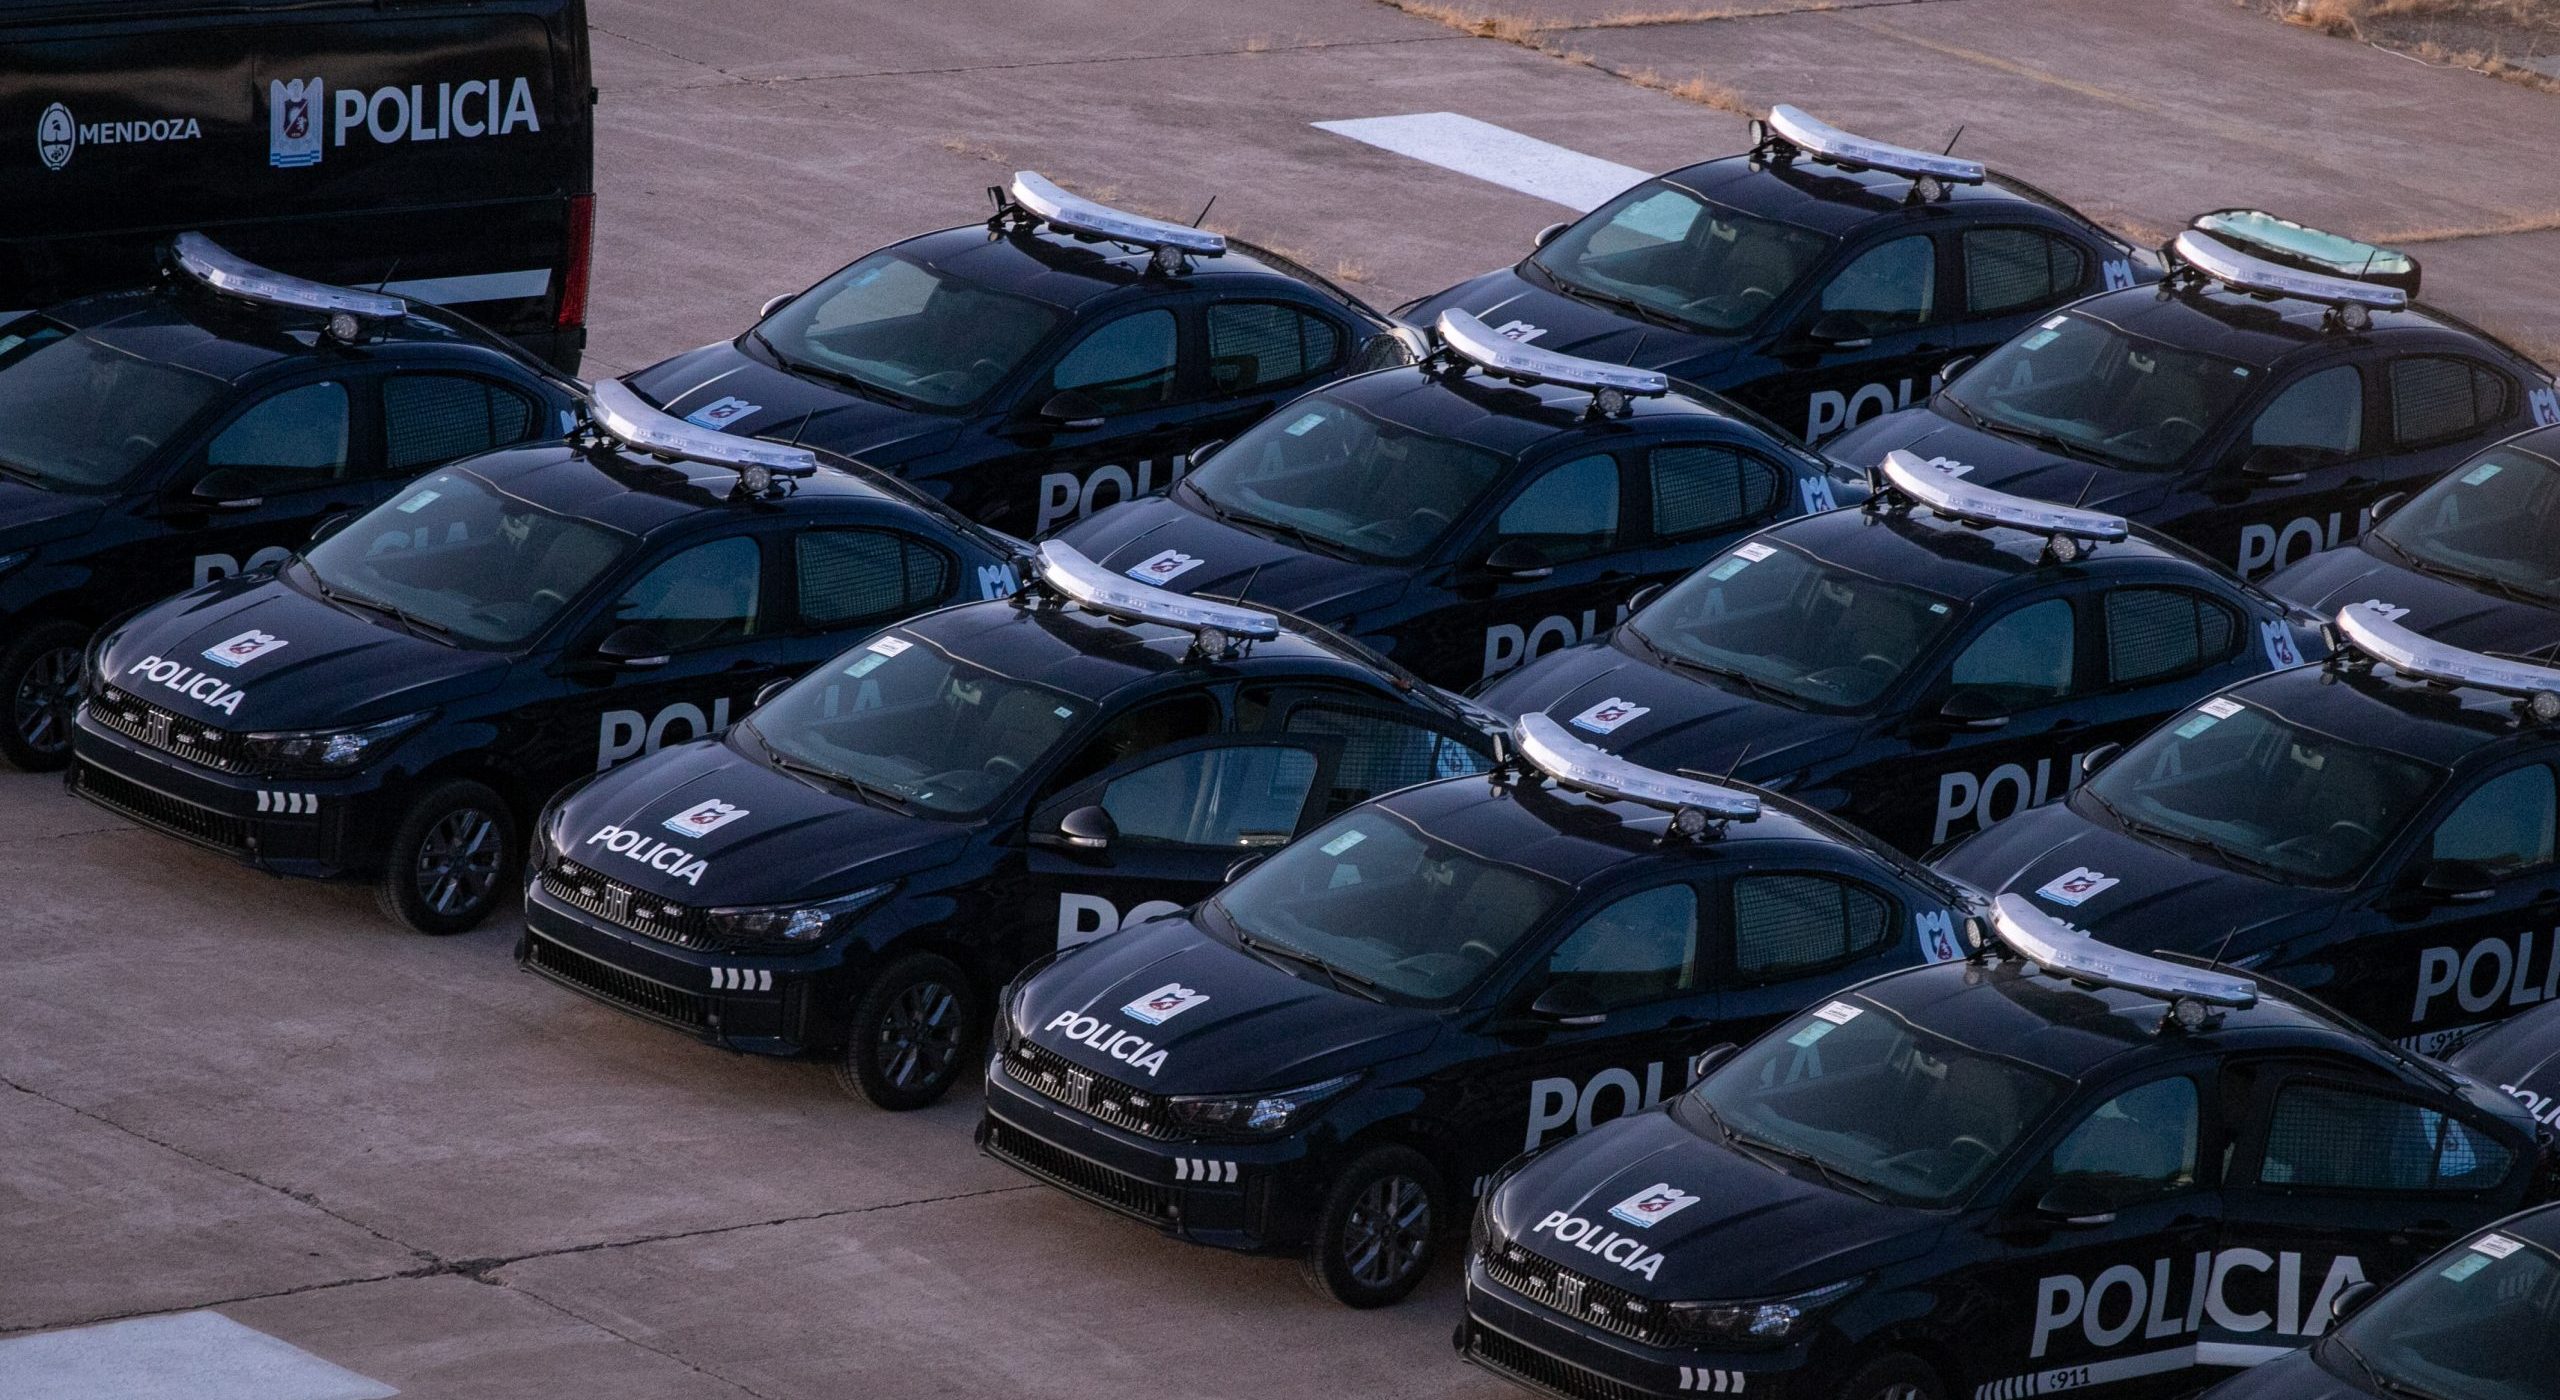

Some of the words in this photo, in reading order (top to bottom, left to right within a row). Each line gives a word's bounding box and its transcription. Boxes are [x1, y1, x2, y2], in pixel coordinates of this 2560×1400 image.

[79, 117, 202, 146] MENDOZA
[334, 76, 541, 148] POLICIA
[128, 654, 247, 716] POLICIA
[586, 824, 710, 887] POLICIA
[1045, 1010, 1170, 1078] POLICIA
[1532, 1210, 1666, 1283] POLICIA
[1555, 1272, 1587, 1314] FIAT
[2029, 1247, 2368, 1359] POLICIA
